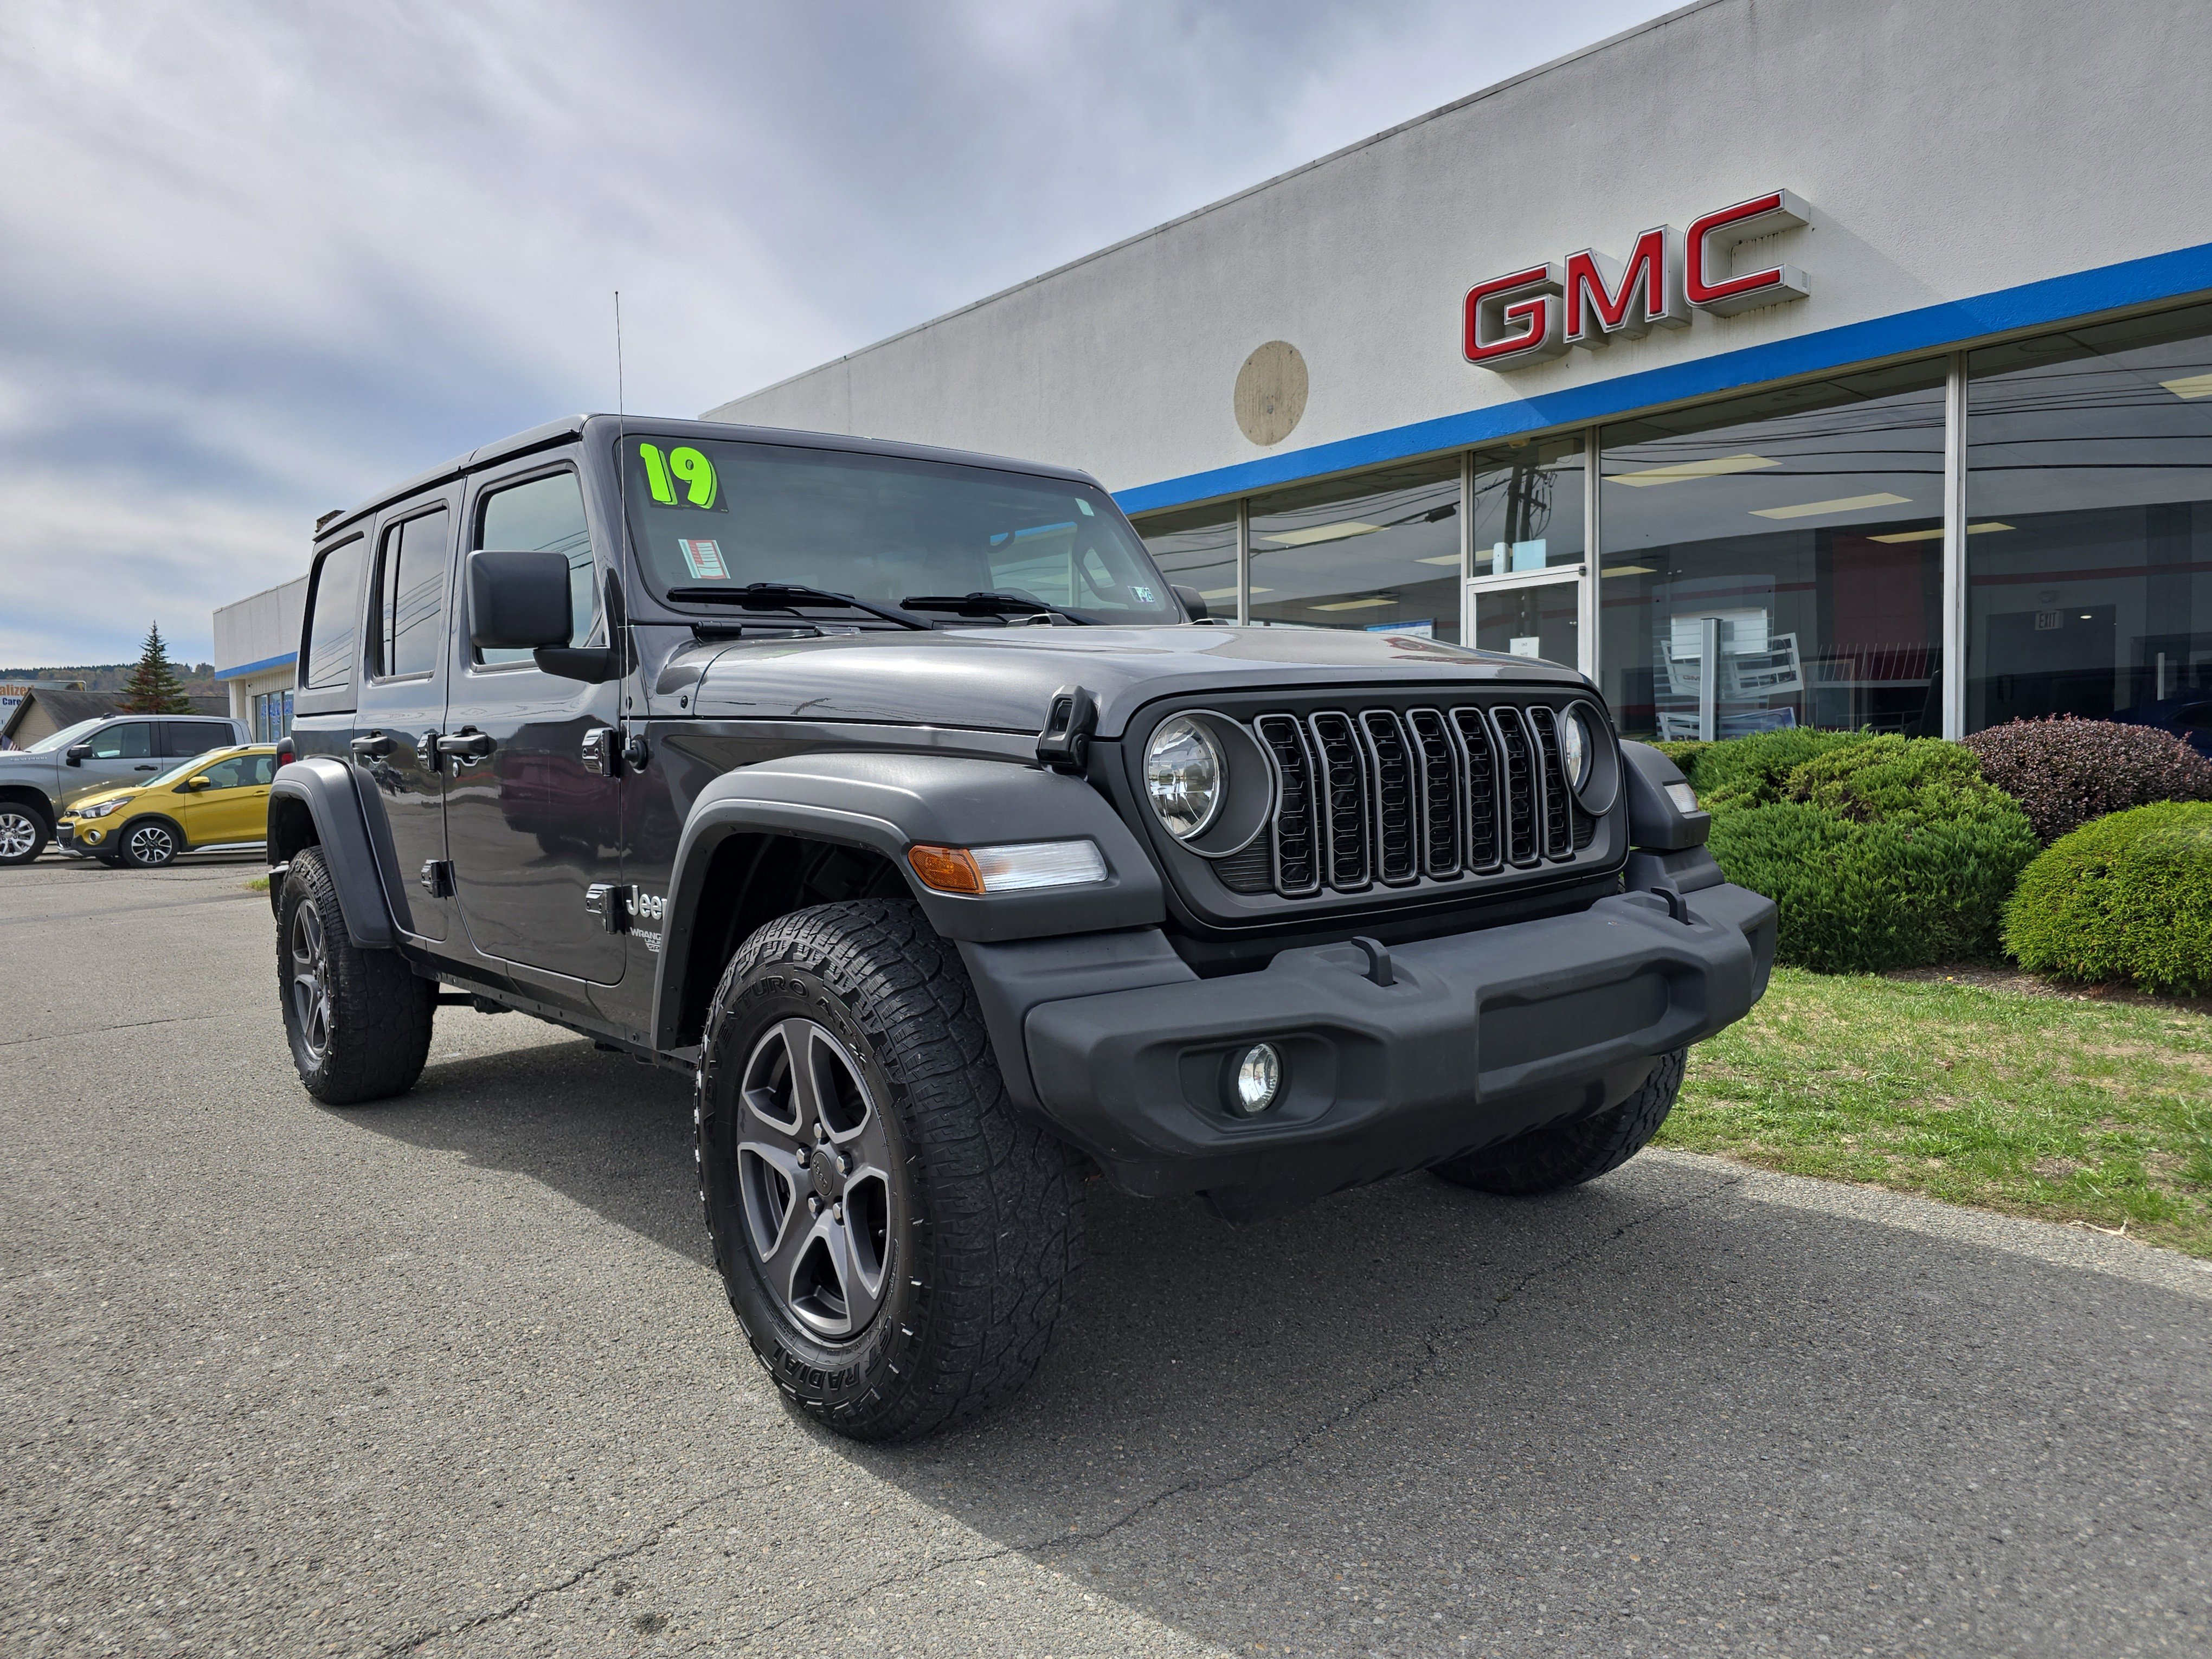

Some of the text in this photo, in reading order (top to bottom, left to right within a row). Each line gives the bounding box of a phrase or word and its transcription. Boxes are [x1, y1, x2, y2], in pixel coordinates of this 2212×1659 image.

[1462, 188, 1786, 365] GMC
[640, 443, 717, 509] 19
[2039, 612, 2057, 629] EXIT
[0, 684, 34, 696] alize
[703, 975, 809, 1147] ADVENTURO
[773, 1336, 861, 1391] RADIAL
